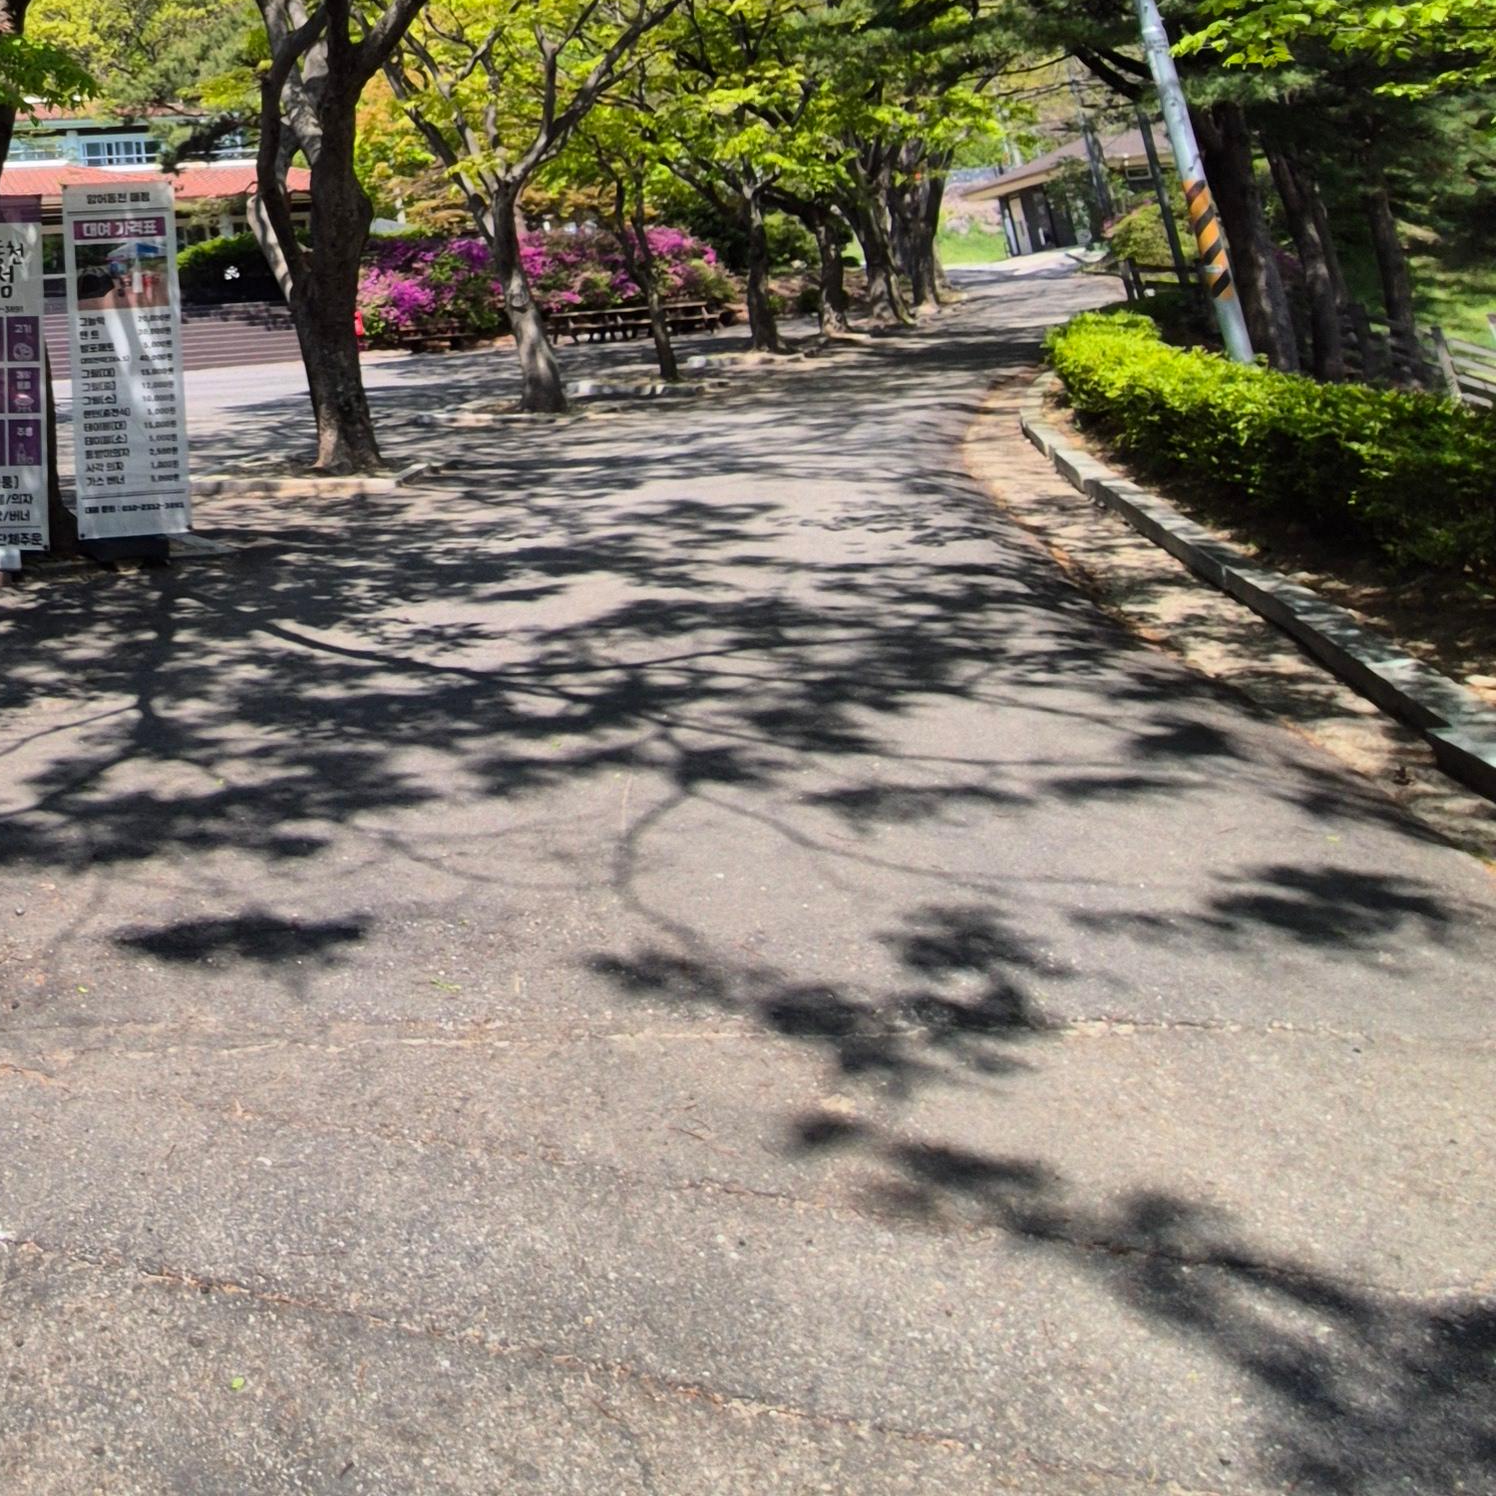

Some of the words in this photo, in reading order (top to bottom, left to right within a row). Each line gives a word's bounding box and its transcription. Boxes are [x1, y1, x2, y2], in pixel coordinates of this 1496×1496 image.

[83, 223, 111, 237] 대여
[115, 219, 157, 236] 가격표
[86, 464, 104, 472] 사각
[106, 461, 124, 471] 의자
[87, 477, 104, 486] 가스
